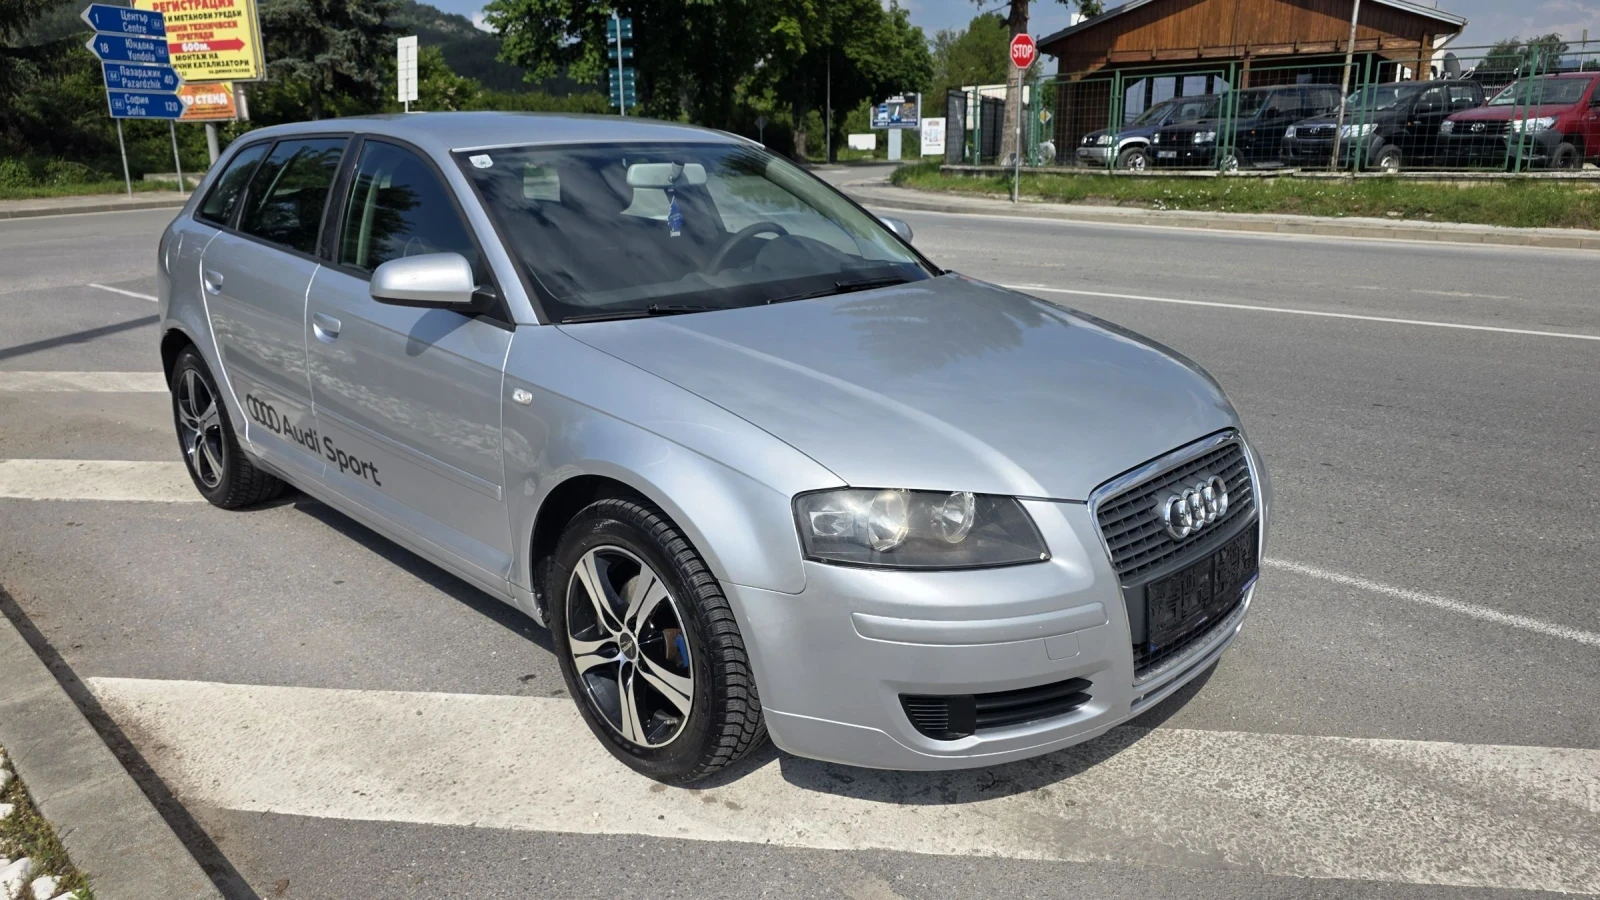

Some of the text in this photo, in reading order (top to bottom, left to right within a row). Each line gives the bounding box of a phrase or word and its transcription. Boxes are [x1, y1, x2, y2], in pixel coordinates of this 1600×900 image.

[152, 0, 234, 13] РЕГИСТРАЦИЯ
[95, 13, 99, 24] 1
[120, 9, 149, 24] Център
[174, 12, 213, 21] МЕТАНОВИ
[122, 21, 147, 34] Centre
[100, 42, 109, 54] 18
[125, 38, 154, 51] Юндола
[127, 50, 156, 62] Yundola
[175, 52, 219, 62] МОНТАЖ НА
[1013, 44, 1033, 58] STOP
[120, 65, 162, 78] Пазарджик
[121, 77, 161, 89] Pazardzhik
[164, 75, 174, 85] 40
[124, 93, 149, 105] София
[126, 105, 146, 116] Sofia
[164, 101, 179, 112] 120
[283, 414, 382, 487] Audi Sport
